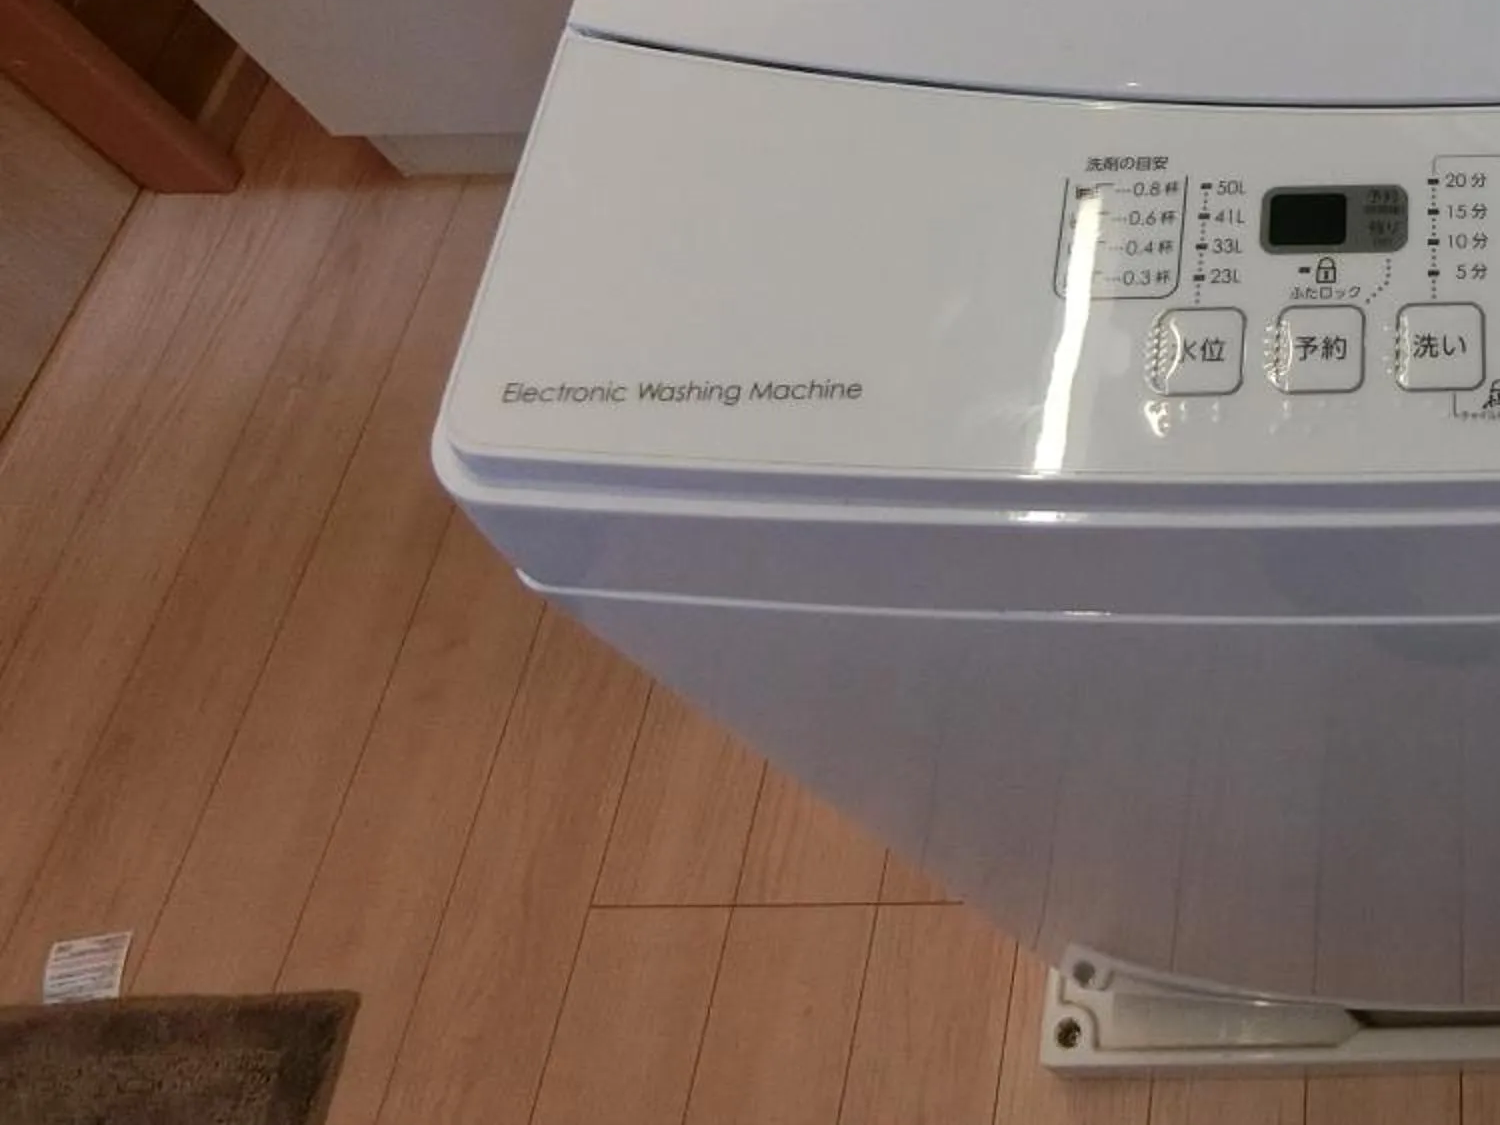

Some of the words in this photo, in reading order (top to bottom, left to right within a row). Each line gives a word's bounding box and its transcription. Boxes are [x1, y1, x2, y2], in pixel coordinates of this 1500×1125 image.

[1086, 156, 1168, 171] 洗剤の目安
[1216, 181, 1246, 196] 50L
[1445, 173, 1487, 189] 20分
[1214, 211, 1245, 226] 41L
[1447, 204, 1488, 220] 15分
[1212, 238, 1243, 255] 33L
[1448, 234, 1489, 250] 10分
[1210, 269, 1240, 285] 23L
[1455, 264, 1488, 281] 5分
[1289, 286, 1361, 300] ふたロック
[1295, 336, 1347, 361] 予約
[1413, 334, 1467, 359] 洗い
[502, 381, 627, 404] Electronic
[638, 381, 742, 406] Washing
[748, 378, 863, 401] Machine
